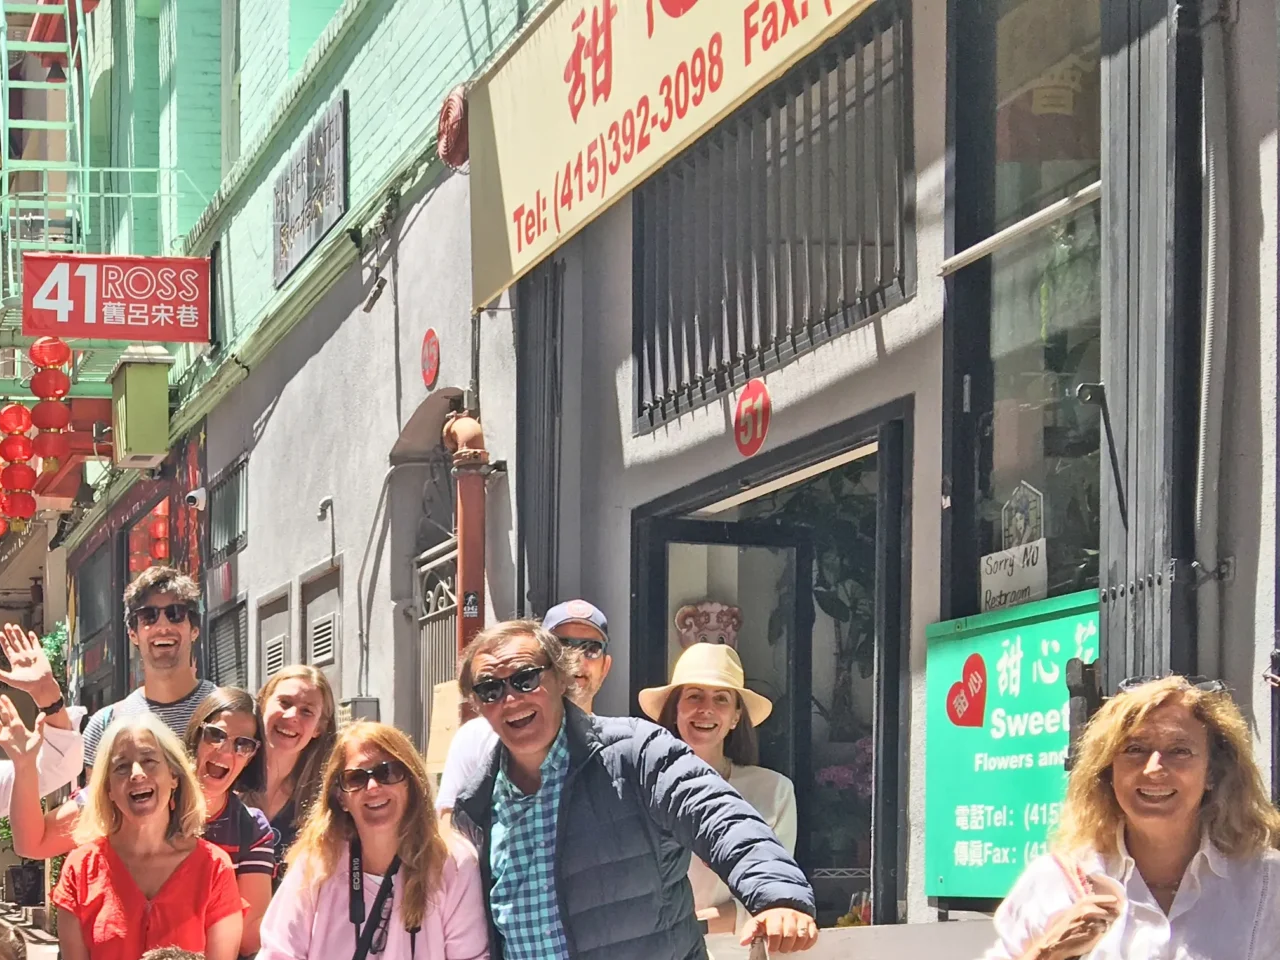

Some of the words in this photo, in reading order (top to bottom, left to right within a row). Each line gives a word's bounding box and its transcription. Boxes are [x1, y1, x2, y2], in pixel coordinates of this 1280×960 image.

[512, 189, 548, 254] Tel:
[553, 31, 724, 233] (415)392-3098
[32, 262, 98, 324] 41
[102, 264, 199, 302] ROSS
[101, 301, 199, 328] 舊呂宋巷
[740, 391, 764, 446] 51
[984, 555, 1015, 576] Sorry
[984, 585, 1031, 611] Restroom
[974, 752, 1034, 773] Flowers
[1038, 745, 1069, 767] and
[352, 871, 361, 891] EOS
